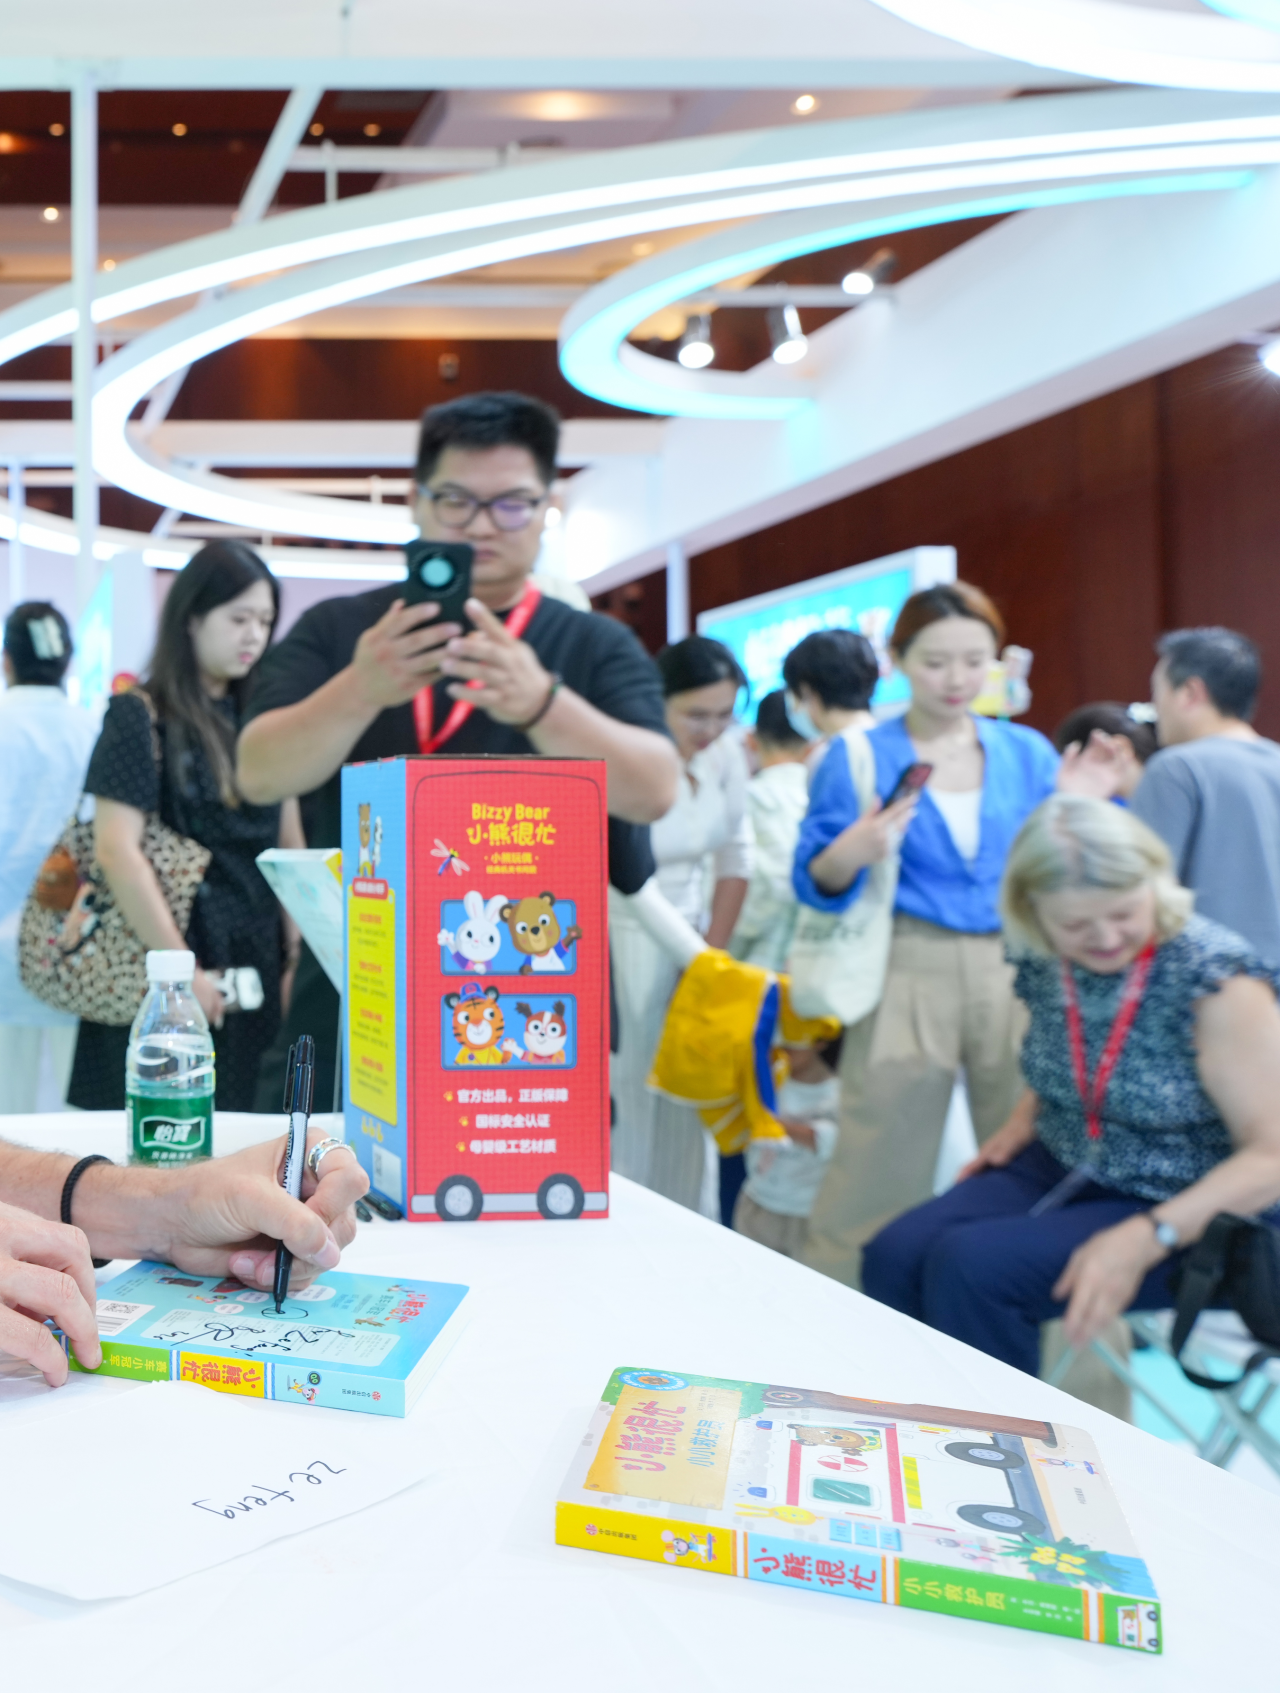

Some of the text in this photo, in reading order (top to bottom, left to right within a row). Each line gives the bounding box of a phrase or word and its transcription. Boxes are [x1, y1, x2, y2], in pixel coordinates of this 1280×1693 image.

[472, 803, 551, 824] Bizzy Bear
[466, 822, 557, 846] 小熊很忙
[457, 1087, 569, 1103] 官方出品，正版保障
[475, 1113, 550, 1129] 国标安全认证
[109, 1354, 168, 1374] 赛车小冠军
[182, 1360, 261, 1389] 小熊很忙
[614, 1400, 687, 1472] 小熊很忙
[753, 1547, 877, 1592] 小熊很忙
[902, 1577, 1007, 1611] 小小救护员
